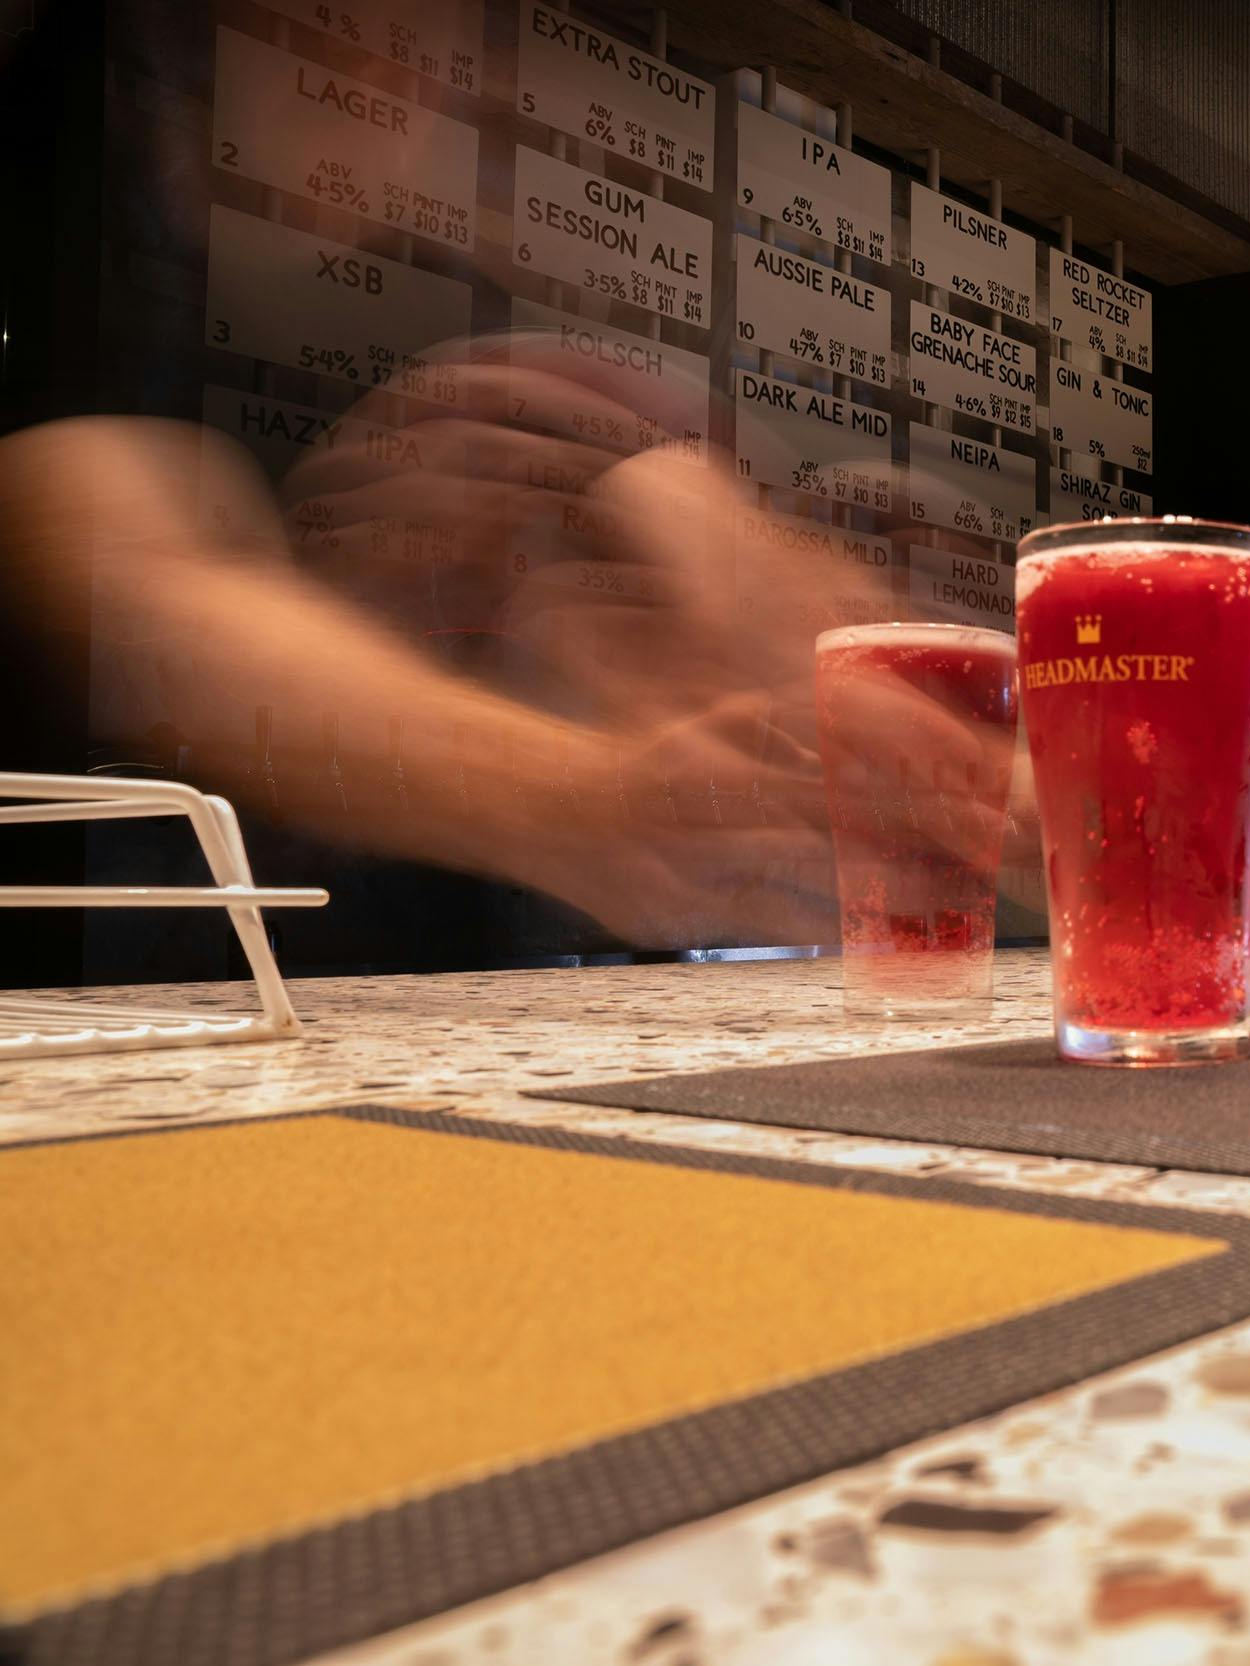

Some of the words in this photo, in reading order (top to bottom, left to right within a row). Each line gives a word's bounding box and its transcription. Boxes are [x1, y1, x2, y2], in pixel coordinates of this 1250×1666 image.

[389, 41, 409, 63] $8
[450, 66, 474, 91] $14
[451, 49, 474, 69] IMP
[532, 7, 619, 71] EXTRA
[628, 55, 706, 110] STOUT
[297, 66, 409, 136] LAGER
[522, 91, 535, 112] 5
[588, 102, 613, 121] ABV
[624, 121, 646, 138] SCH
[656, 133, 677, 153] PINT
[687, 148, 705, 165] IMP
[220, 141, 239, 166] 2
[585, 119, 616, 146] 6%
[629, 138, 646, 158] $8
[658, 150, 675, 171] $11
[683, 161, 703, 183] $14
[801, 137, 841, 176] IPA
[316, 158, 352, 179] ABV
[383, 182, 409, 202] SCH
[413, 192, 444, 217] PINT
[447, 202, 468, 223] IMP
[584, 179, 645, 224] GUM
[742, 187, 754, 204] 9
[384, 201, 406, 222] $7
[414, 210, 439, 233] $10
[444, 220, 468, 245] $13
[793, 195, 813, 211] ABV
[836, 216, 854, 233] SCH
[869, 229, 885, 245] IMP
[943, 204, 1007, 250] PILSNER
[518, 243, 532, 262] 6
[527, 196, 638, 260] SESSION
[650, 241, 699, 279] ALE
[837, 230, 850, 248] $8
[315, 249, 384, 296] XSB
[754, 248, 824, 293] AUSSIE
[831, 275, 876, 312] PALE
[911, 258, 926, 277] 13
[1063, 258, 1090, 284] RED
[1097, 273, 1145, 310] ROCKET
[631, 270, 650, 288] SCH
[655, 280, 678, 298] PINT
[686, 289, 703, 305] IMP
[632, 285, 648, 305] $8
[657, 295, 673, 315] $11
[684, 303, 702, 323] $14
[1052, 316, 1063, 332] 17
[1072, 287, 1130, 328] SELTZER
[213, 320, 231, 343] 3
[738, 321, 755, 341] 10
[800, 328, 819, 343] ABV
[828, 338, 845, 354] SCH
[850, 346, 868, 362] PINT
[930, 312, 976, 347] BABY
[983, 333, 1021, 365] FACE
[367, 344, 395, 365] SCH
[560, 324, 662, 377] KOLSCH
[829, 350, 842, 369] $7
[850, 358, 865, 377] $10
[871, 366, 886, 384] $13
[911, 331, 995, 380] GRENACHE
[998, 363, 1036, 394] SOUR
[372, 364, 393, 386] $7
[401, 370, 426, 394] $10
[433, 381, 457, 403] $13
[912, 377, 926, 396] 14
[1057, 367, 1082, 393] GIN
[1093, 379, 1103, 400] &
[1112, 386, 1150, 417] TONIC
[512, 397, 527, 418] 7
[743, 375, 798, 413] DARK
[806, 395, 844, 425] ALE
[852, 408, 888, 437] MID
[240, 401, 343, 449] HAZY
[1052, 426, 1064, 442] 18
[950, 439, 1000, 472] NEIPA
[1088, 440, 1106, 458] 5%
[738, 457, 751, 476] 11
[832, 467, 849, 481] SCH
[835, 481, 847, 498] $7
[853, 486, 869, 504] $10
[959, 500, 976, 513] ABV
[1060, 472, 1112, 504] SHIRAZ
[1119, 490, 1140, 513] GIN
[297, 501, 335, 521] ABV
[912, 501, 926, 519] 15
[297, 520, 341, 549] 7%
[743, 515, 834, 558] BAROSSA
[843, 539, 888, 568] MILD
[513, 552, 529, 574] 8
[952, 558, 999, 587] HARD
